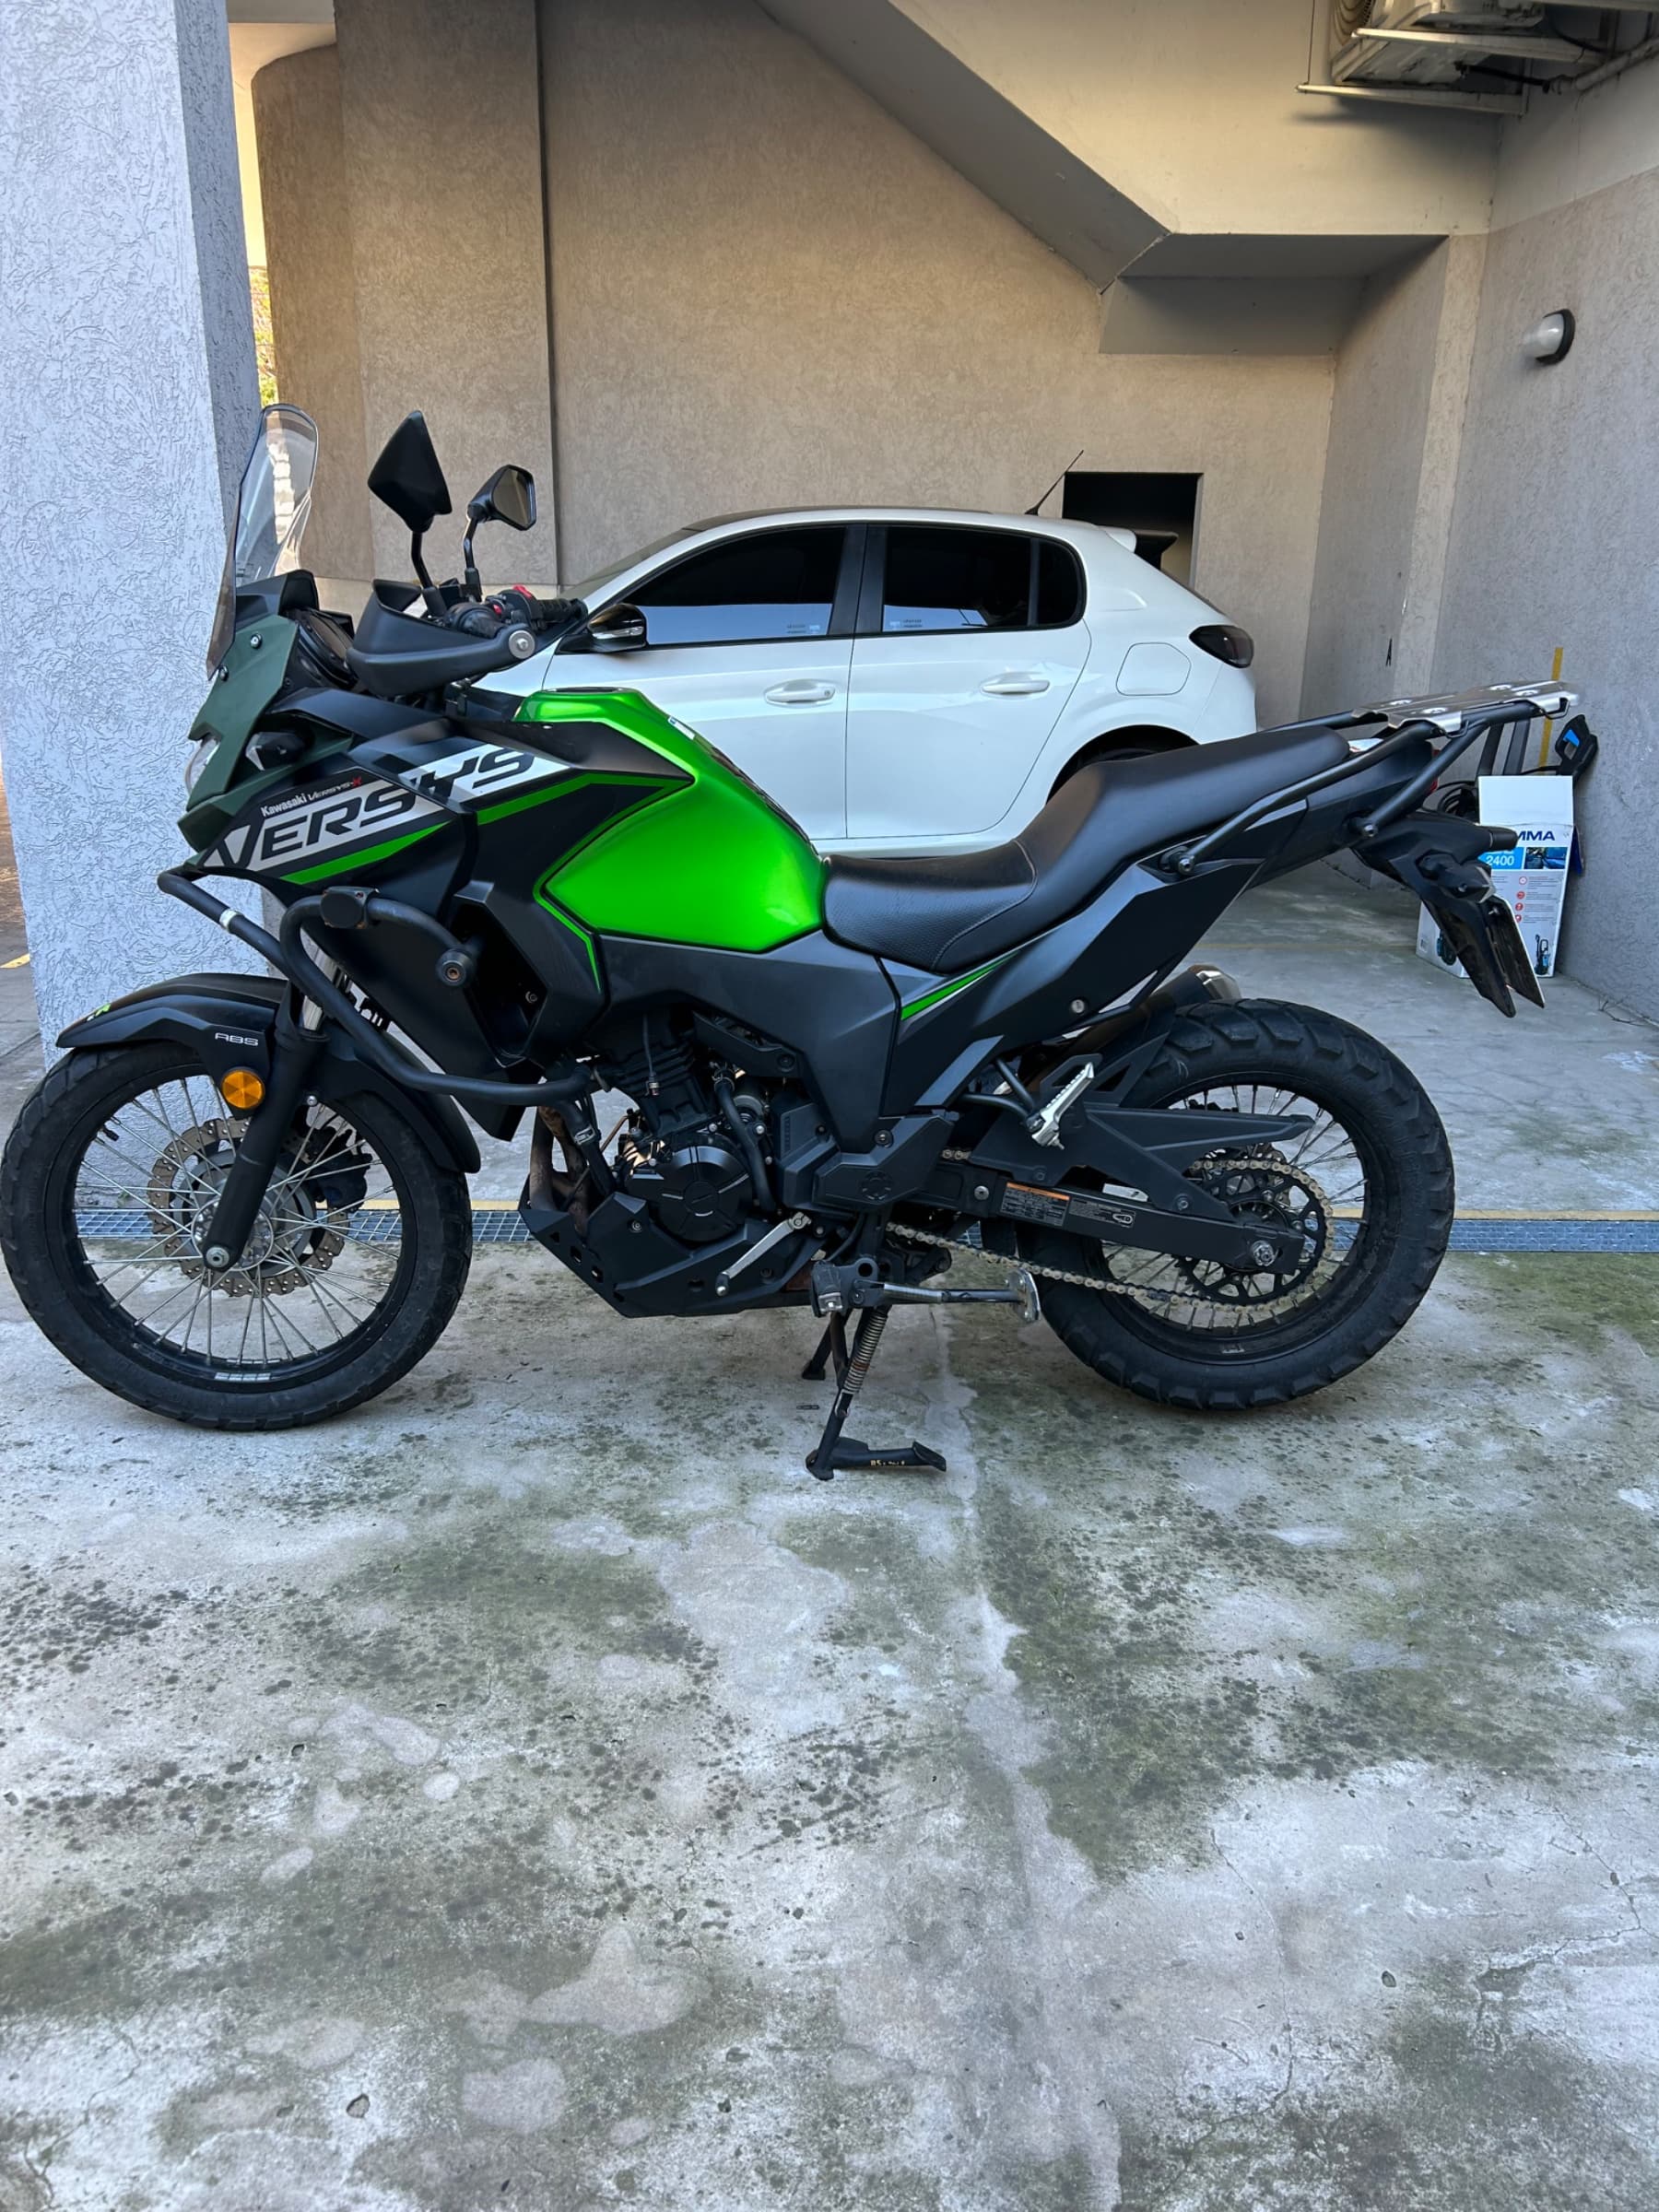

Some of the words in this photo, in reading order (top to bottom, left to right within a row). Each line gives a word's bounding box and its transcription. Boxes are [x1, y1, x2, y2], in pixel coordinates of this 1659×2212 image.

[260, 793, 307, 817] Kawasaki
[1517, 830, 1556, 841] MMA
[1486, 855, 1514, 866] 2400
[215, 1032, 259, 1047] ABS
